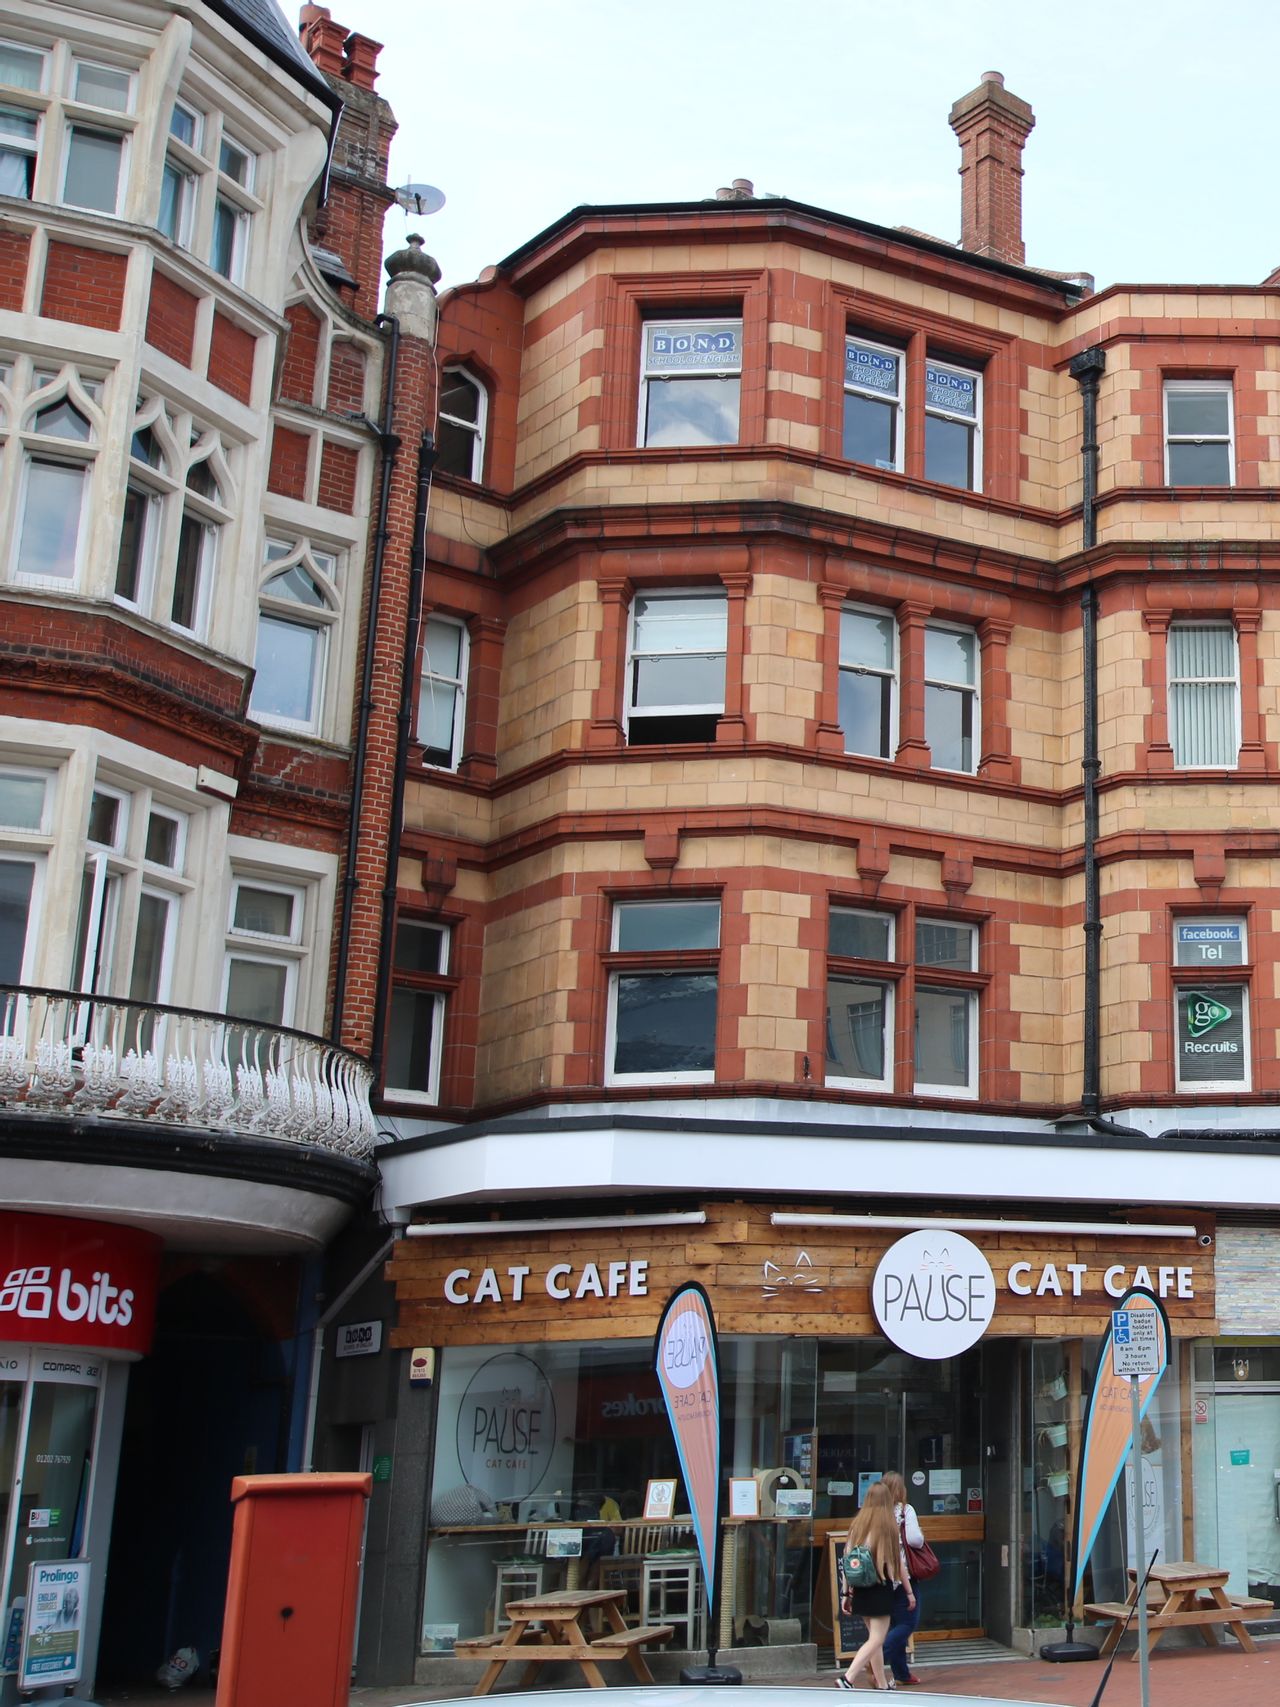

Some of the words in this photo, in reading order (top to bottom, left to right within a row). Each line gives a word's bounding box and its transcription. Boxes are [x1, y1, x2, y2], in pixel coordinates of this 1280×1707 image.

[654, 335, 733, 352] BOND
[649, 356, 686, 365] SCHOOL
[687, 355, 699, 364] OF
[700, 354, 739, 363] ENGLISH
[848, 350, 893, 369] BOND
[847, 364, 881, 378] SCHOOL
[882, 373, 895, 381] OF
[852, 372, 889, 388] ENGLISH
[928, 372, 971, 391] BOND
[928, 385, 960, 398] SCHOOL
[960, 394, 972, 402] OF
[932, 393, 967, 409] ENGLISH
[1198, 944, 1222, 959] Tel
[1195, 1001, 1219, 1026] go
[1185, 1042, 1238, 1053] Recruits
[444, 1266, 530, 1304] CAT
[545, 1260, 648, 1299] CAFE
[1007, 1261, 1088, 1296] CAT
[1103, 1265, 1195, 1299] CAFE
[57, 1268, 134, 1326] bits
[884, 1273, 986, 1322] PAUSE
[1117, 1313, 1127, 1326] P
[43, 1362, 81, 1375] COMPAQ
[1231, 1359, 1249, 1370] 121
[472, 1406, 541, 1455] PAUSE
[486, 1458, 502, 1469] CAT
[505, 1458, 528, 1469] CAFE
[40, 1569, 79, 1583] Prolingo
